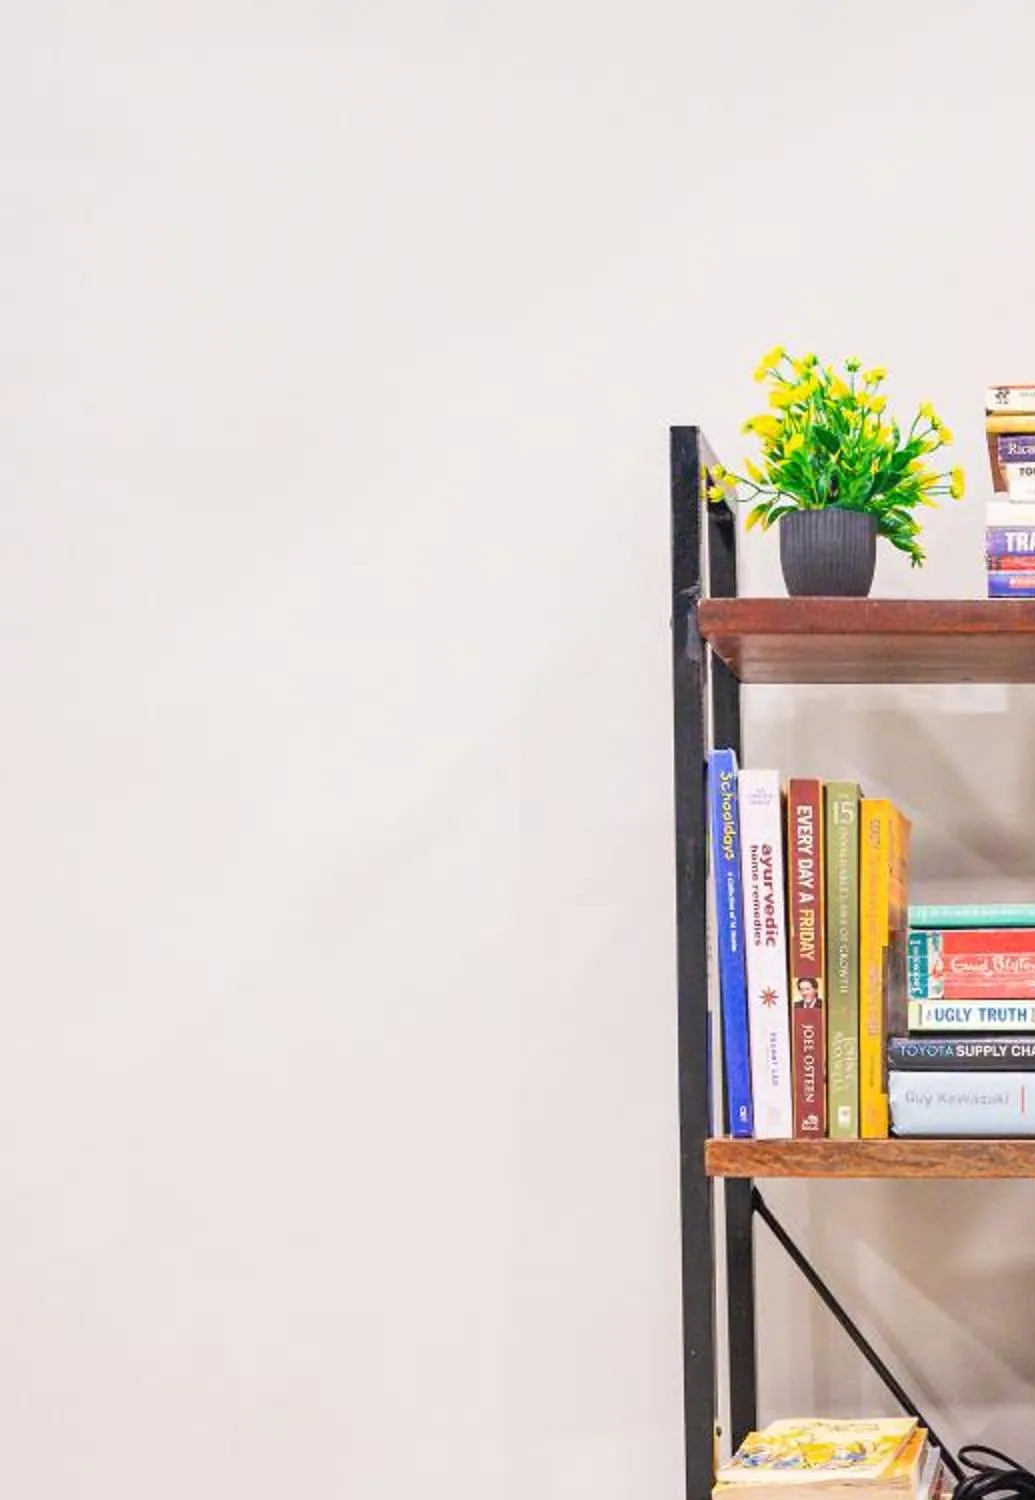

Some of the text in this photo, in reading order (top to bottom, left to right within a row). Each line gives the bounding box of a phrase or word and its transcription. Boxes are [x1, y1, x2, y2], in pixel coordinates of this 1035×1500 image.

[720, 771, 737, 861] Schooldays
[750, 845, 762, 947] home remedies
[761, 844, 778, 948] ayurvedic
[797, 805, 815, 960] EVERY DAY A FRIDAY
[950, 957, 988, 975] Enid
[934, 1006, 972, 1024] UGLY
[978, 1005, 1028, 1023] TRUTH
[802, 1023, 815, 1054] JOEL
[899, 1046, 954, 1058] TOYOTA
[955, 1045, 1008, 1058] SUPPLY
[802, 1055, 816, 1103] OSTEEN
[904, 1090, 933, 1108] Guy
